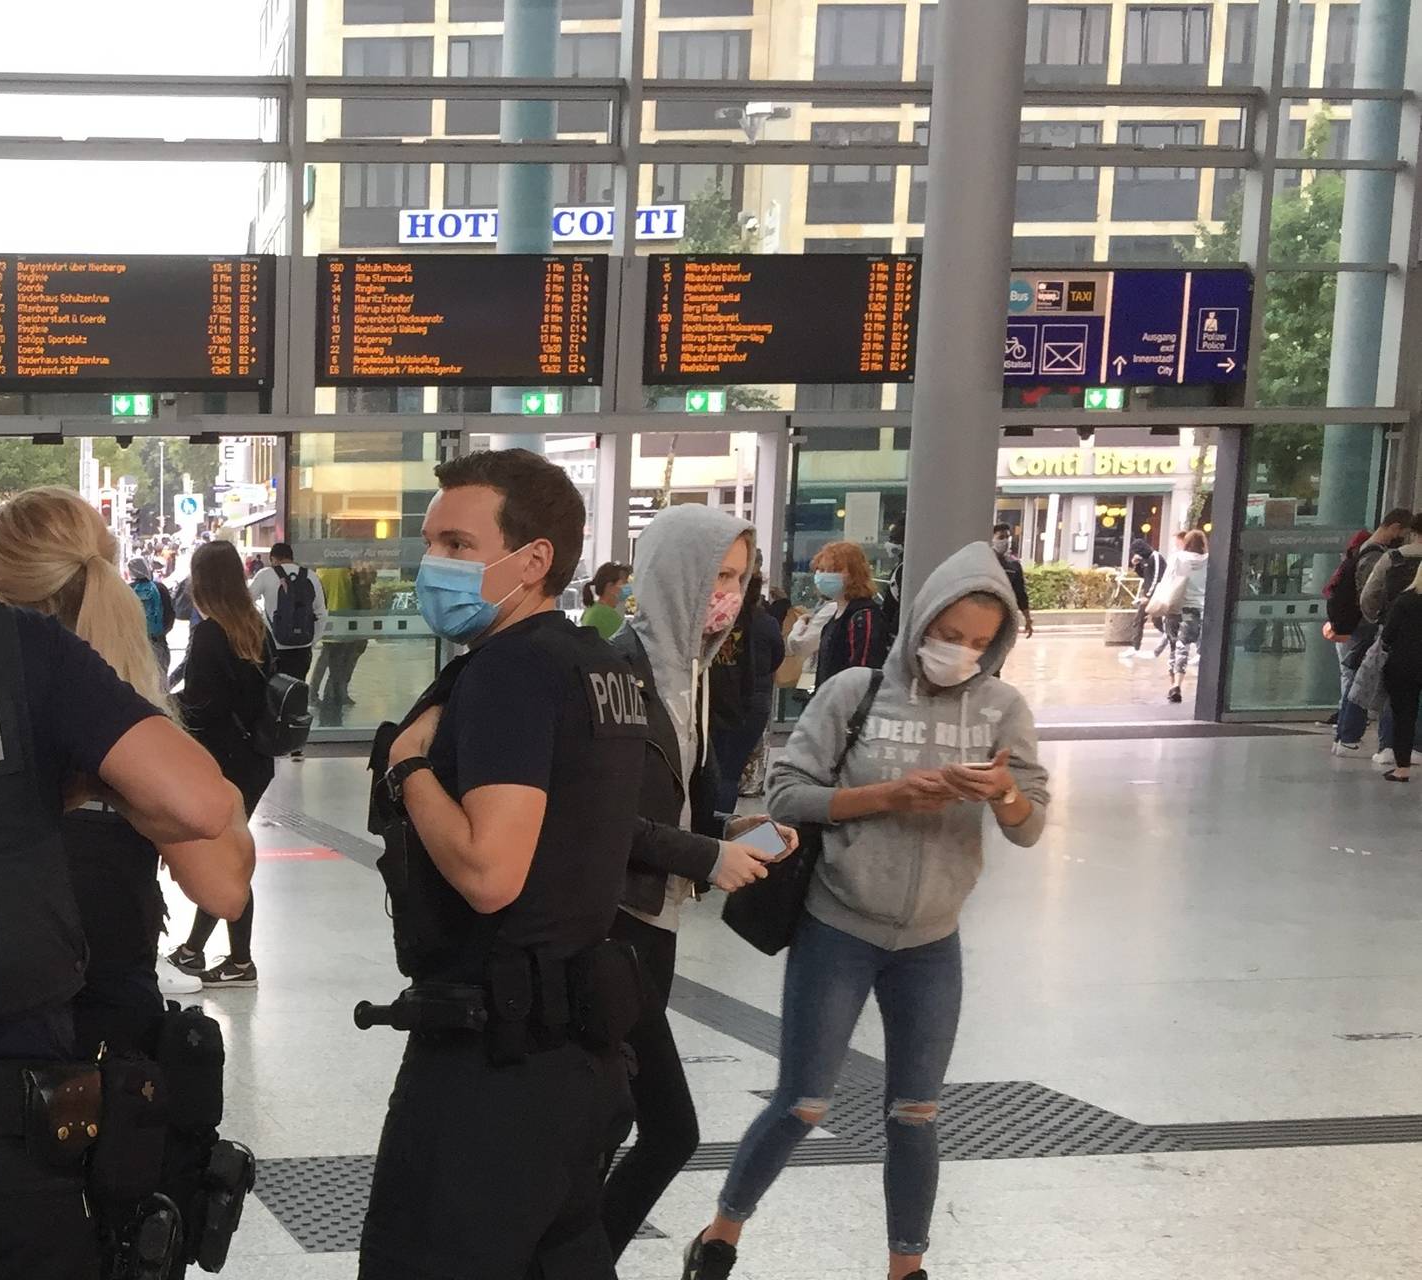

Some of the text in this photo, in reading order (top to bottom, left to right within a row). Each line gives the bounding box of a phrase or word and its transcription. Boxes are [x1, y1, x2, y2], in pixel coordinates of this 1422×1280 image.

[406, 212, 509, 238] HOT
[1071, 291, 1092, 302] TAXI
[1142, 333, 1177, 345] Ausgang
[1202, 332, 1227, 342] Polizei
[1202, 341, 1225, 350] Police
[1133, 354, 1174, 364] Innenstadt
[1157, 365, 1174, 377] City
[1009, 450, 1083, 477] Conti
[1093, 450, 1176, 476] Bistro
